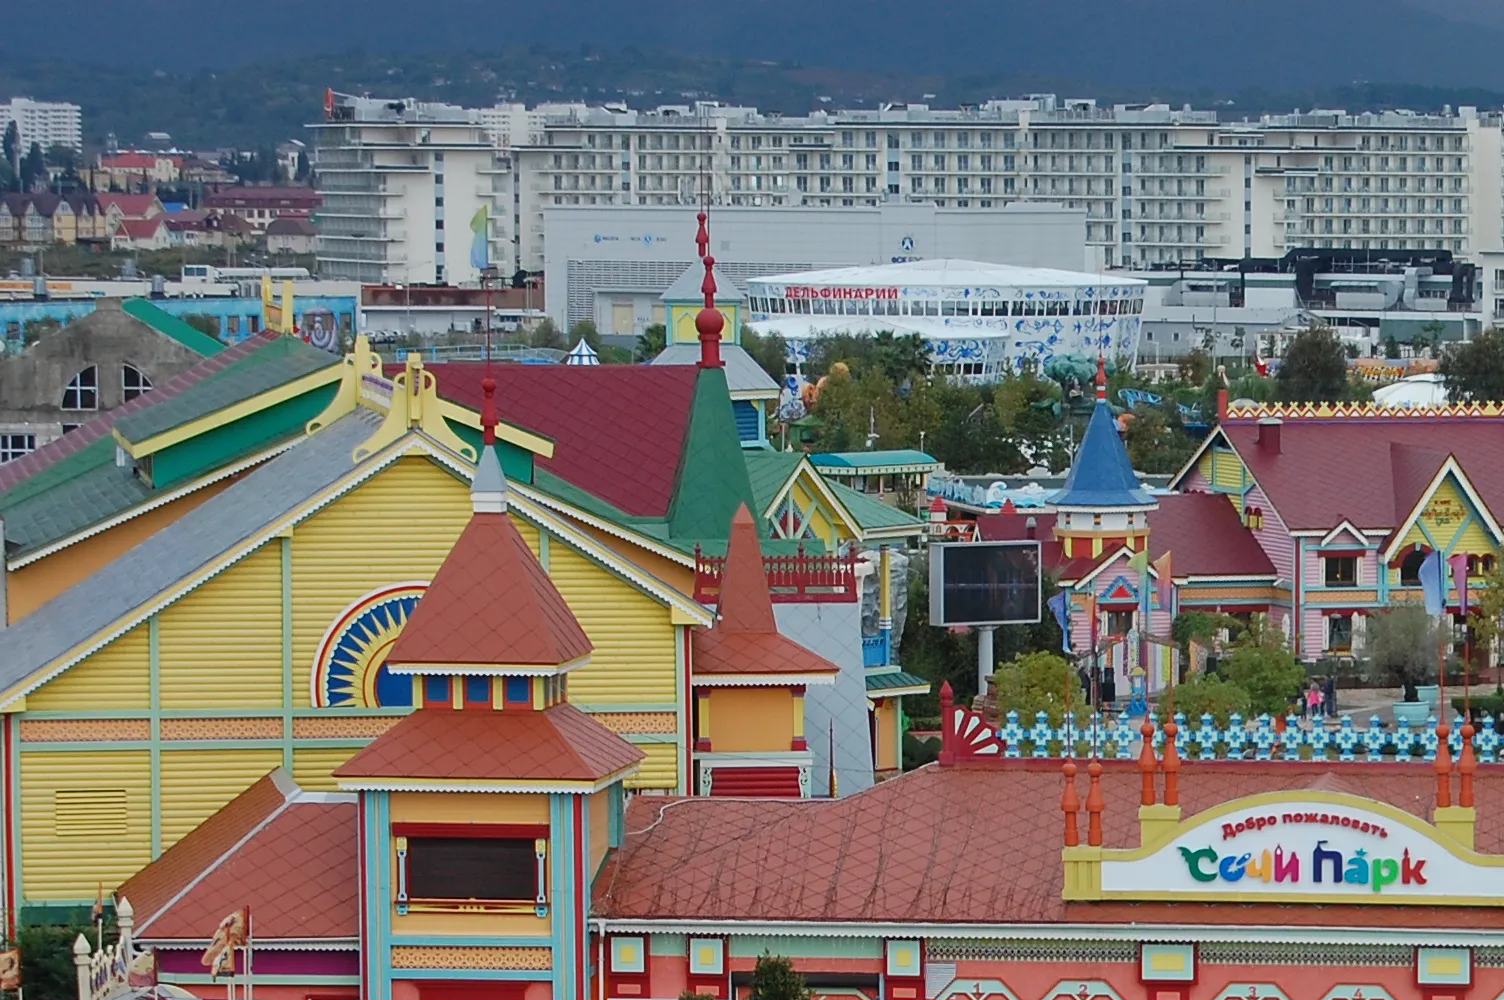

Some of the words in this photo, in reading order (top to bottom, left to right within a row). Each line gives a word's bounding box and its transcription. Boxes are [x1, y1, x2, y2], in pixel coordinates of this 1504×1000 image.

[785, 285, 899, 300] ДЕЛЬФИНАРИЙ
[1221, 814, 1278, 841] Добро
[1282, 811, 1389, 839] пожаловать
[1177, 844, 1300, 883] Сочи
[973, 982, 980, 994] 1
[1078, 984, 1088, 995] 2
[1248, 986, 1257, 998] 3
[1353, 987, 1363, 1000] 4
